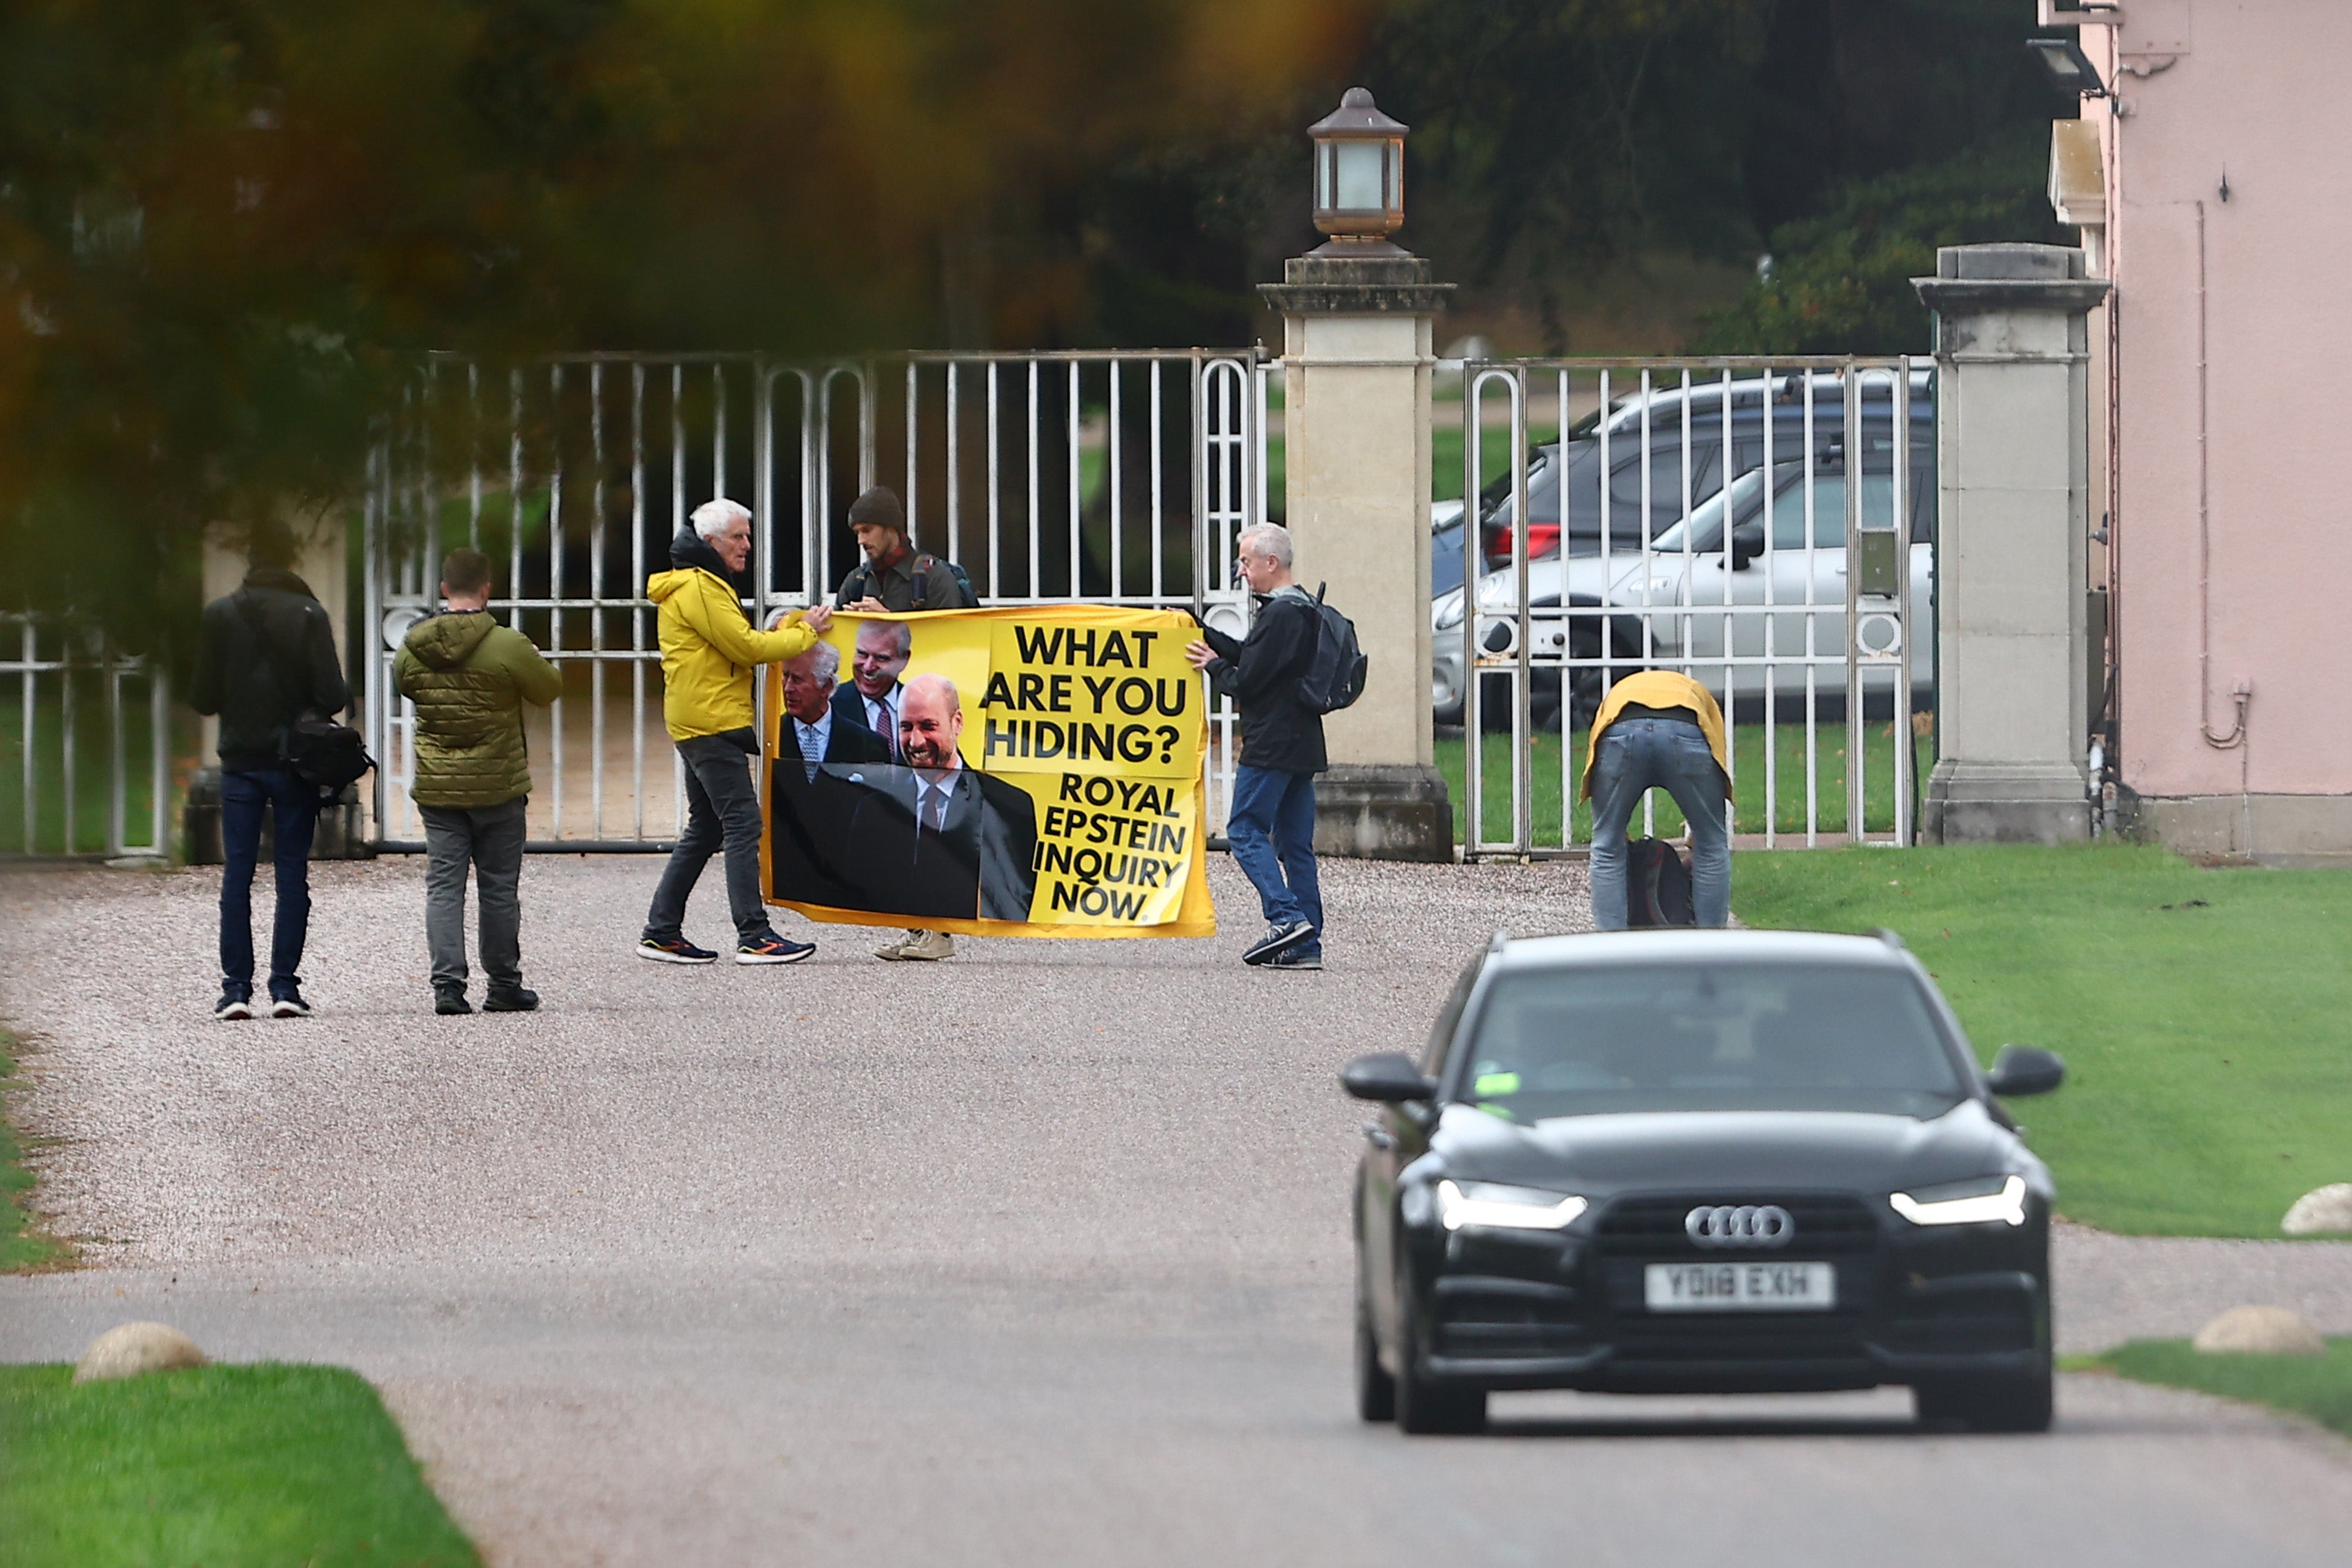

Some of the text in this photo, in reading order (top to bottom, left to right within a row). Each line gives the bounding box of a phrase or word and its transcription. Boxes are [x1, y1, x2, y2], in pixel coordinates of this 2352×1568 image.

[1015, 626, 1158, 669] WHAT
[979, 672, 1186, 717] ARE YOU
[986, 719, 1179, 763] HIDING?
[1060, 772, 1180, 818] ROYAL
[1044, 807, 1186, 854] EPSTEIN
[1034, 841, 1184, 889] INQUIRY
